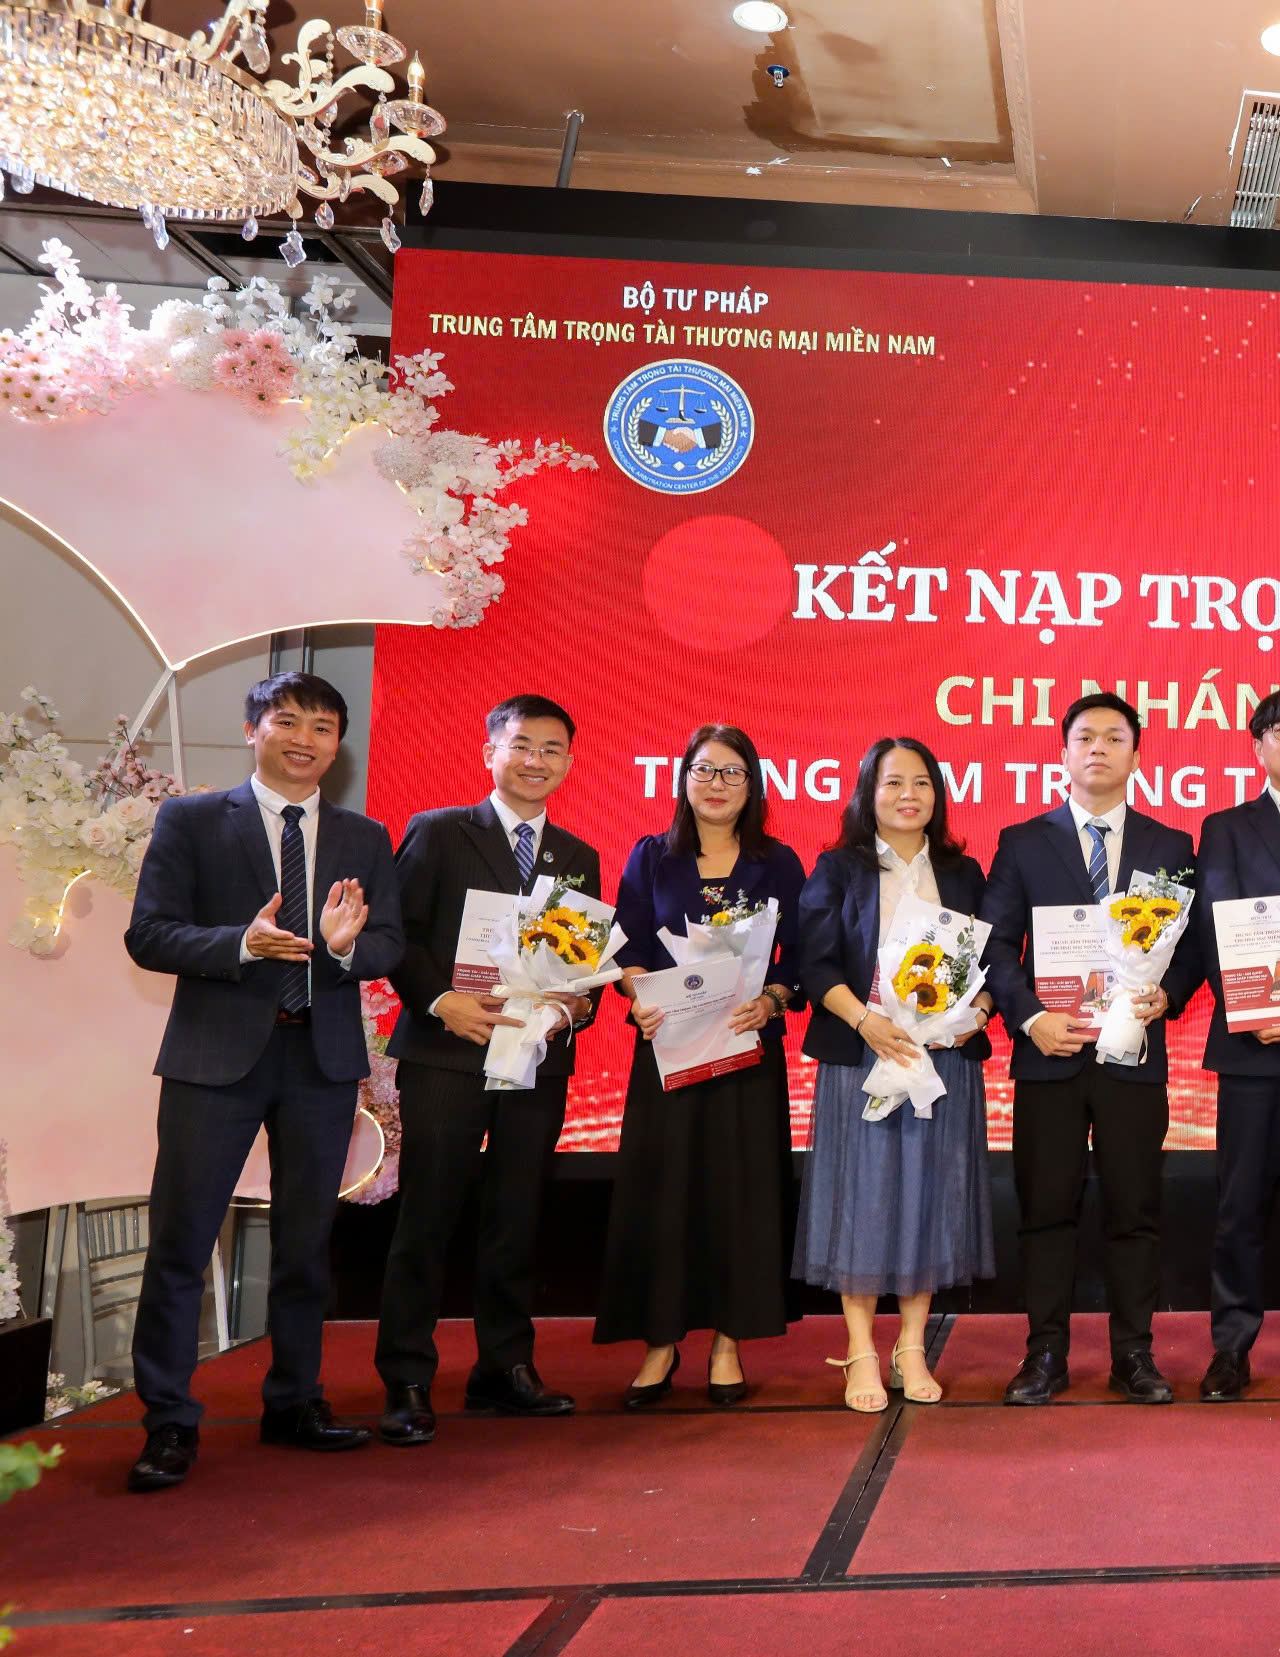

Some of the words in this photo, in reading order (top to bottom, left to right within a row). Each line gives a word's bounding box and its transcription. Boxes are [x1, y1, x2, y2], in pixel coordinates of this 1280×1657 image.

[623, 280, 656, 315] BỘ
[663, 288, 698, 312] TƯ
[704, 285, 769, 315] PHÁP
[429, 313, 503, 336] TRUNG
[510, 311, 557, 339] TÂM
[563, 320, 635, 346] TRỌNG
[642, 318, 675, 345] TÀI
[683, 325, 773, 349] THƯƠNG
[779, 330, 818, 355] MẠI
[826, 325, 880, 353] MIỀN
[888, 334, 936, 356] NAM
[792, 540, 948, 622] KẾT
[964, 569, 1122, 645] NẠP
[935, 675, 1056, 726] CHI
[1004, 762, 1206, 808] TRNG
